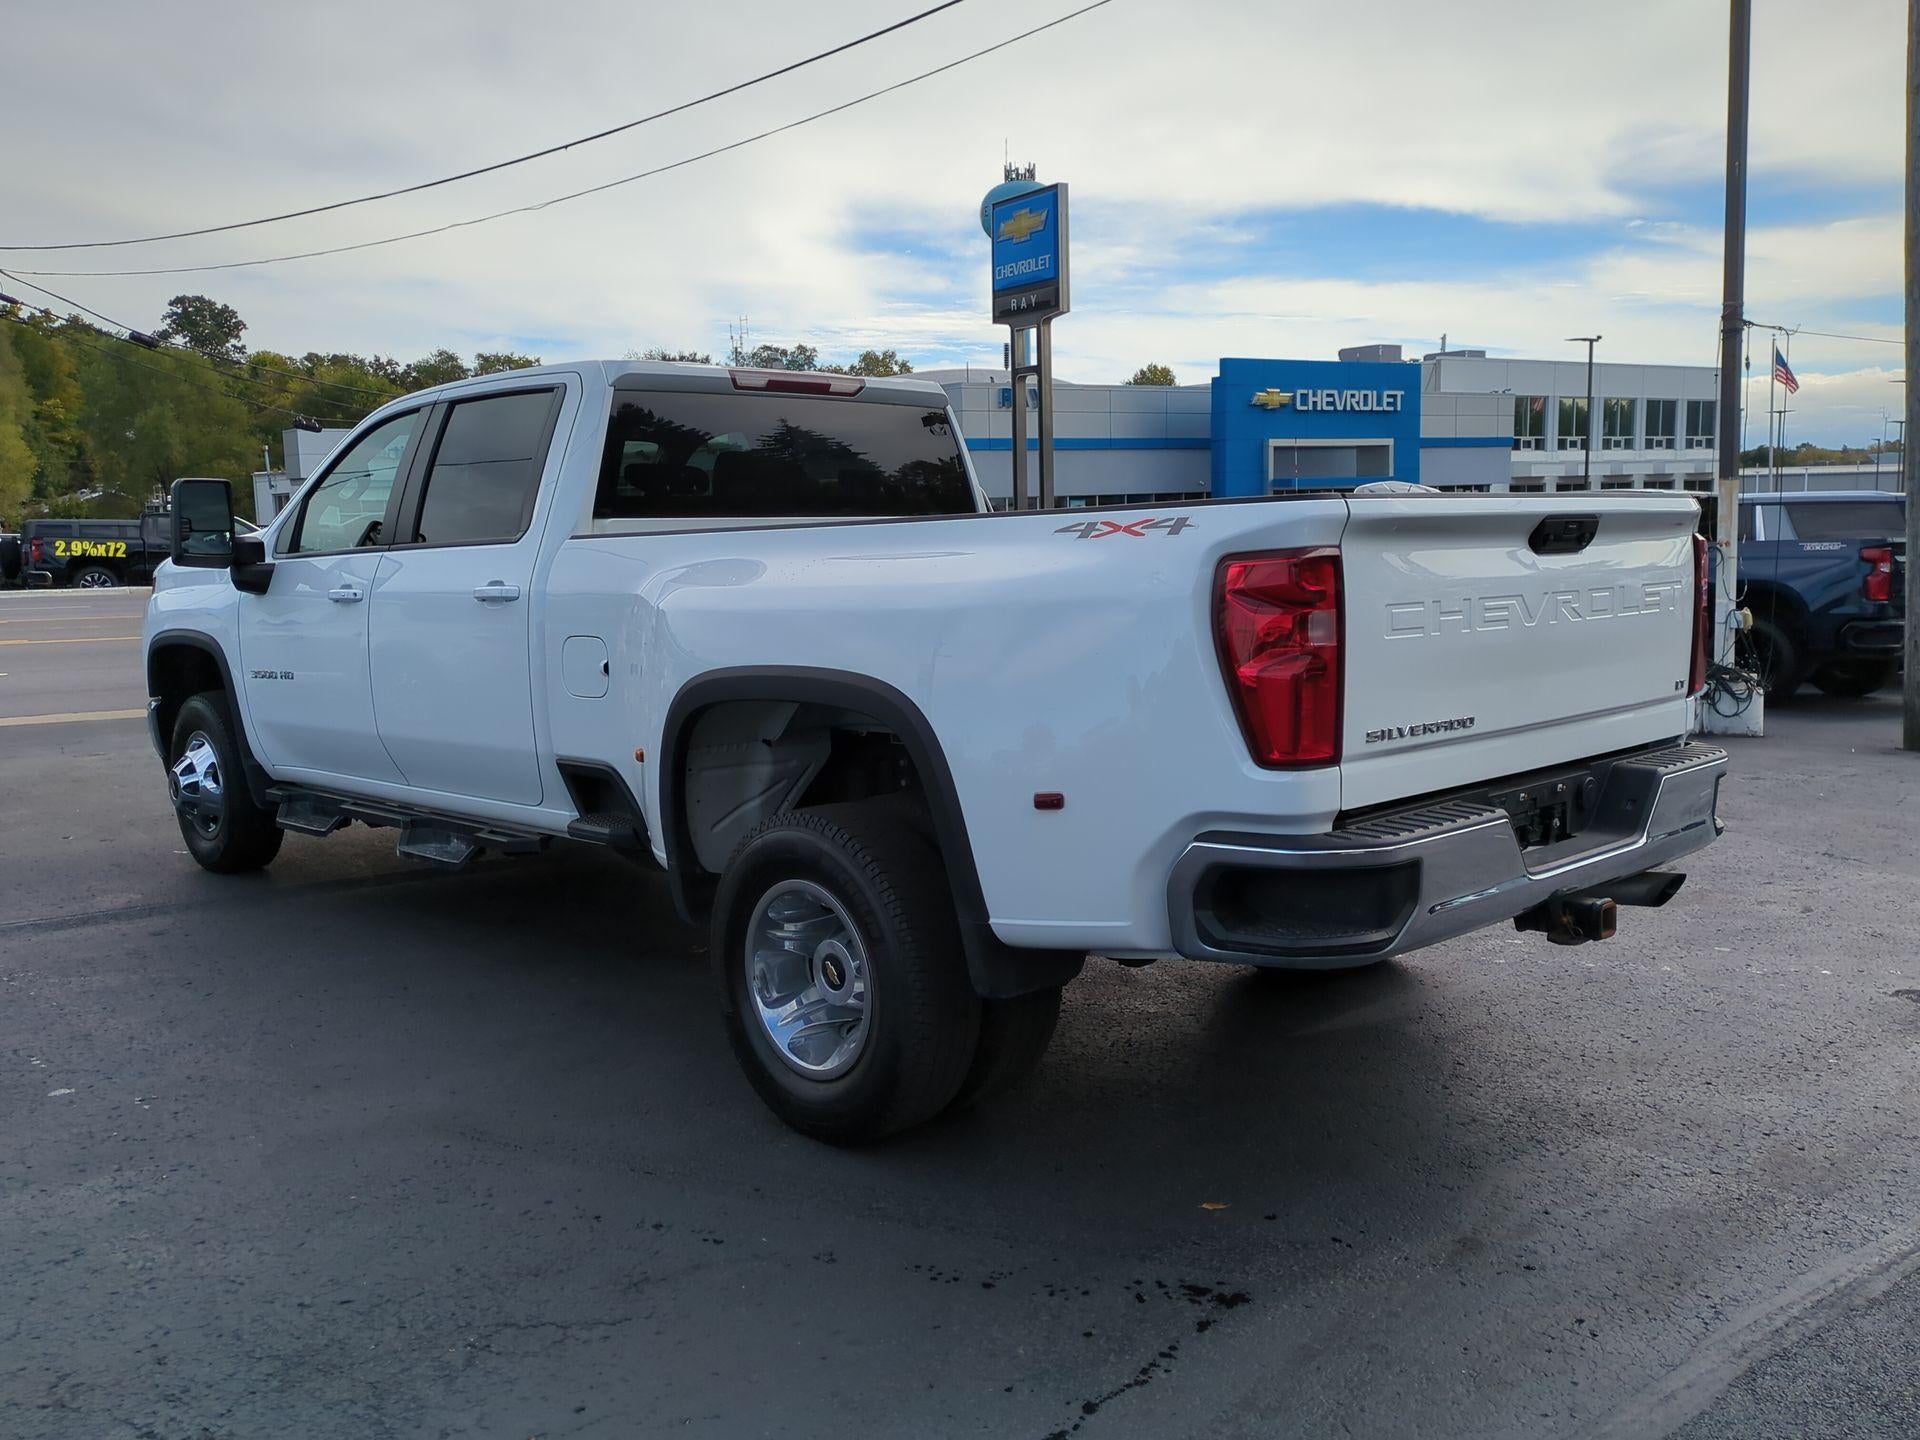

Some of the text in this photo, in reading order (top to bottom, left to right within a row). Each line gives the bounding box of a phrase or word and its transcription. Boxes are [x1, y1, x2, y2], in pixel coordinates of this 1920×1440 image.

[995, 254, 1051, 280] CHEVROLET
[1010, 294, 1037, 311] RAY
[1295, 389, 1405, 412] CHEVROLET
[1384, 579, 1682, 640] CHEVROLET
[250, 670, 295, 680] 3500 HD
[1674, 679, 1685, 691] LT
[1365, 716, 1475, 744] SILVERADO
